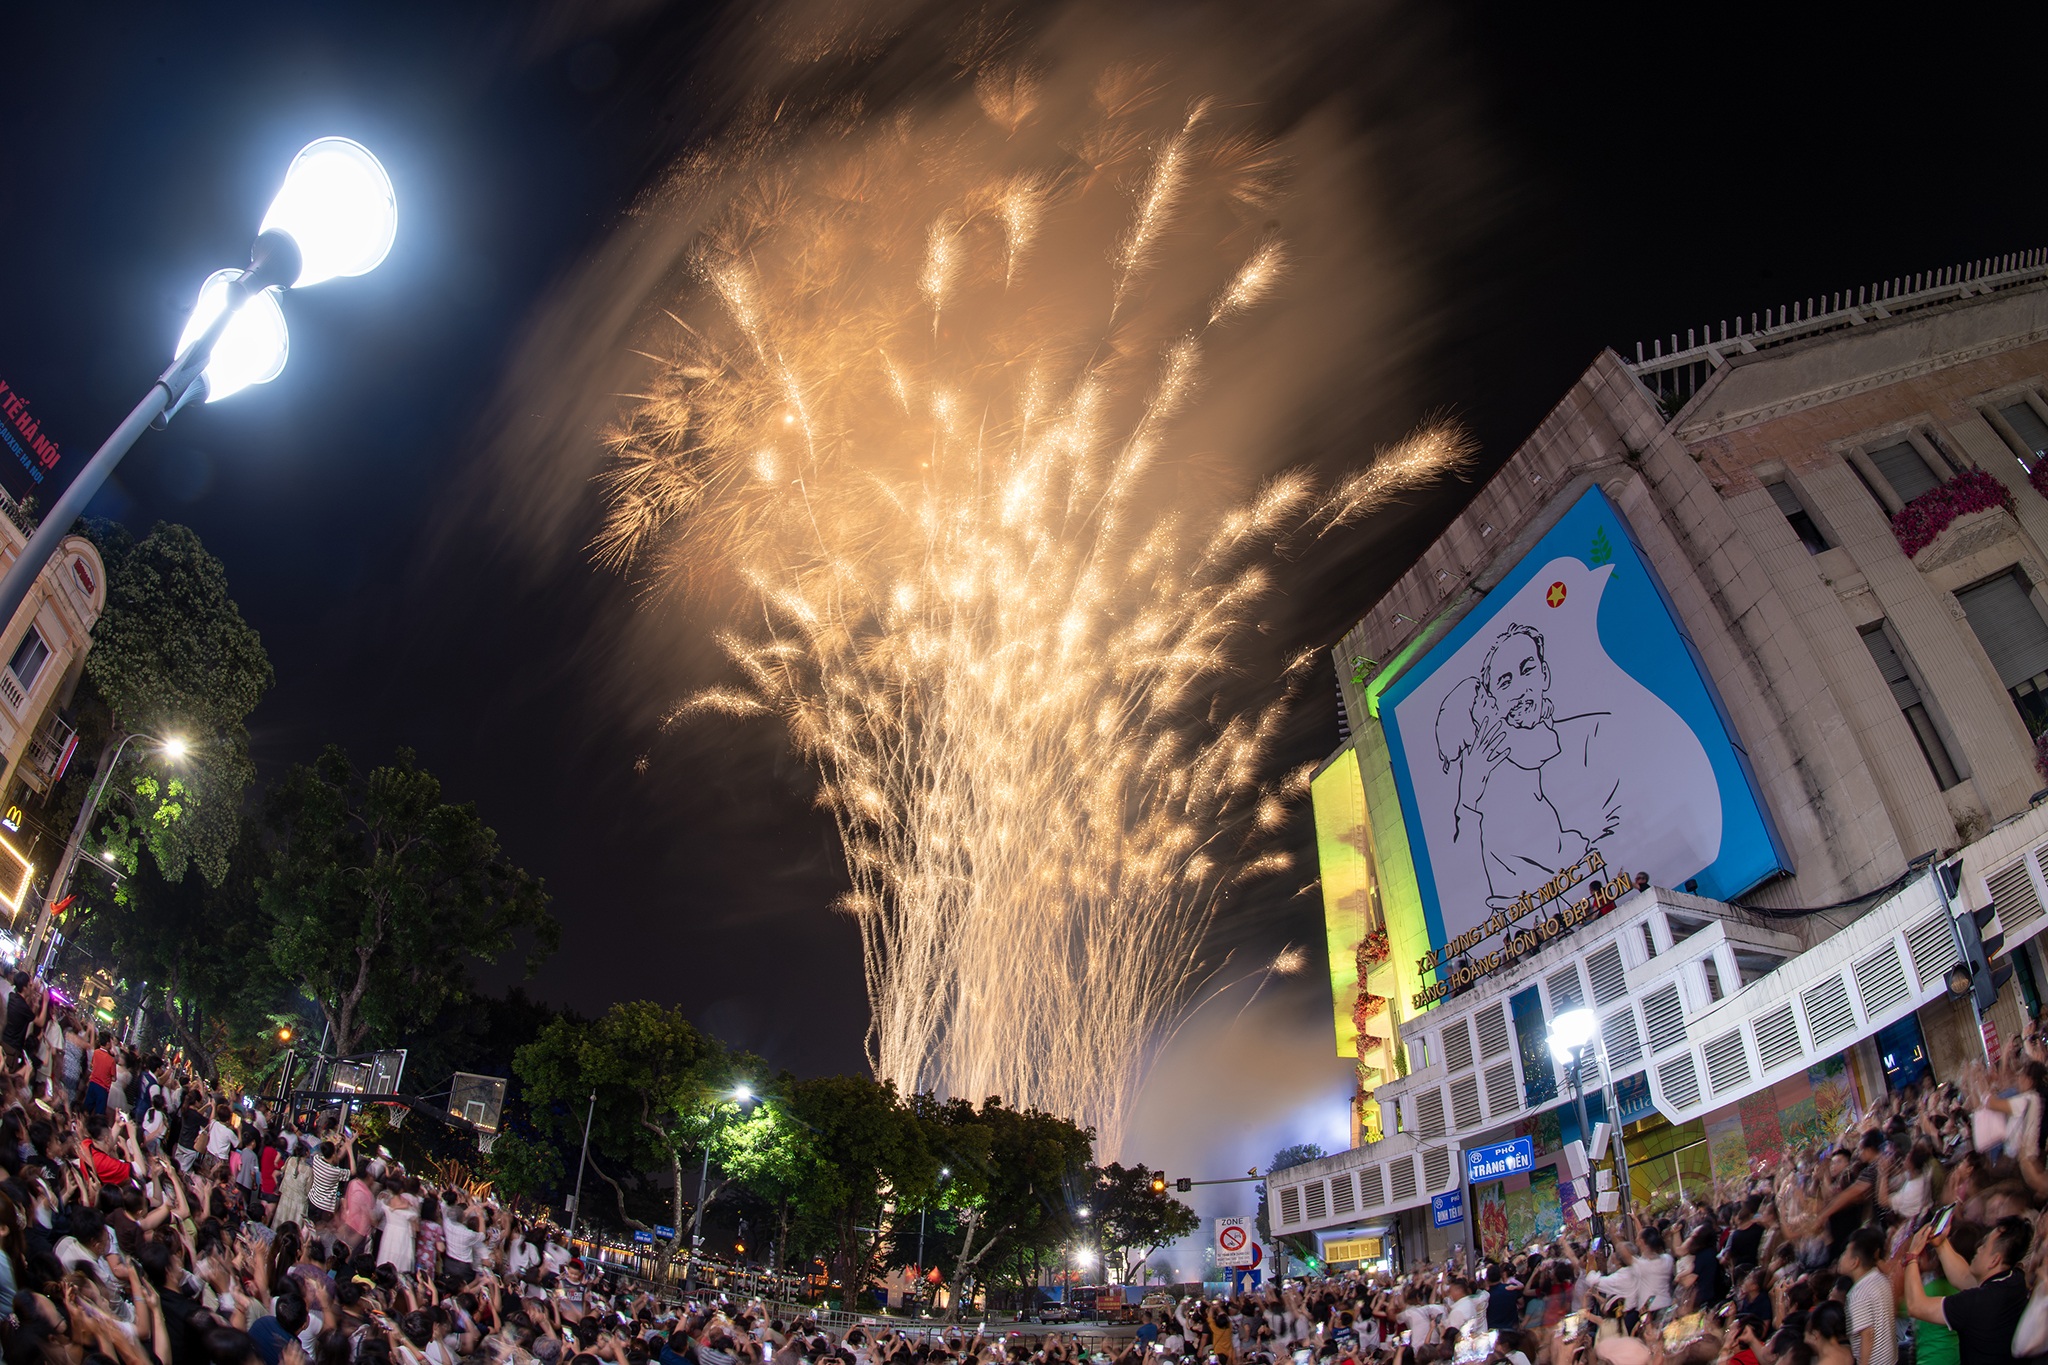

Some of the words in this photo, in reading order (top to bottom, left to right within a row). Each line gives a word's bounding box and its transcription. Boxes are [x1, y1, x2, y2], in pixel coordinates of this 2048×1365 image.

[2, 391, 30, 420] TẾ
[15, 411, 40, 443] HÀ
[32, 433, 61, 469] NỘI
[1415, 949, 1439, 975] XÂY
[1444, 927, 1481, 959] DỰNG
[1482, 912, 1508, 937] LẠI
[1508, 890, 1534, 920] ĐẤT
[1538, 865, 1583, 903] NƯỚC
[1584, 851, 1605, 873] TA
[1411, 979, 1448, 1010] ĐÀNG
[1451, 951, 1501, 988] HOÀNG
[1504, 929, 1537, 960] HƠN
[1539, 918, 1559, 940] TO
[1562, 898, 1590, 928] ĐẸP
[1594, 872, 1632, 908] HƠN
[1473, 1160, 1505, 1177] TRÀNG
[1506, 1152, 1529, 1171] IỀN
[1495, 1144, 1515, 1156] PHỐ
[1221, 1217, 1244, 1226] ZONE
